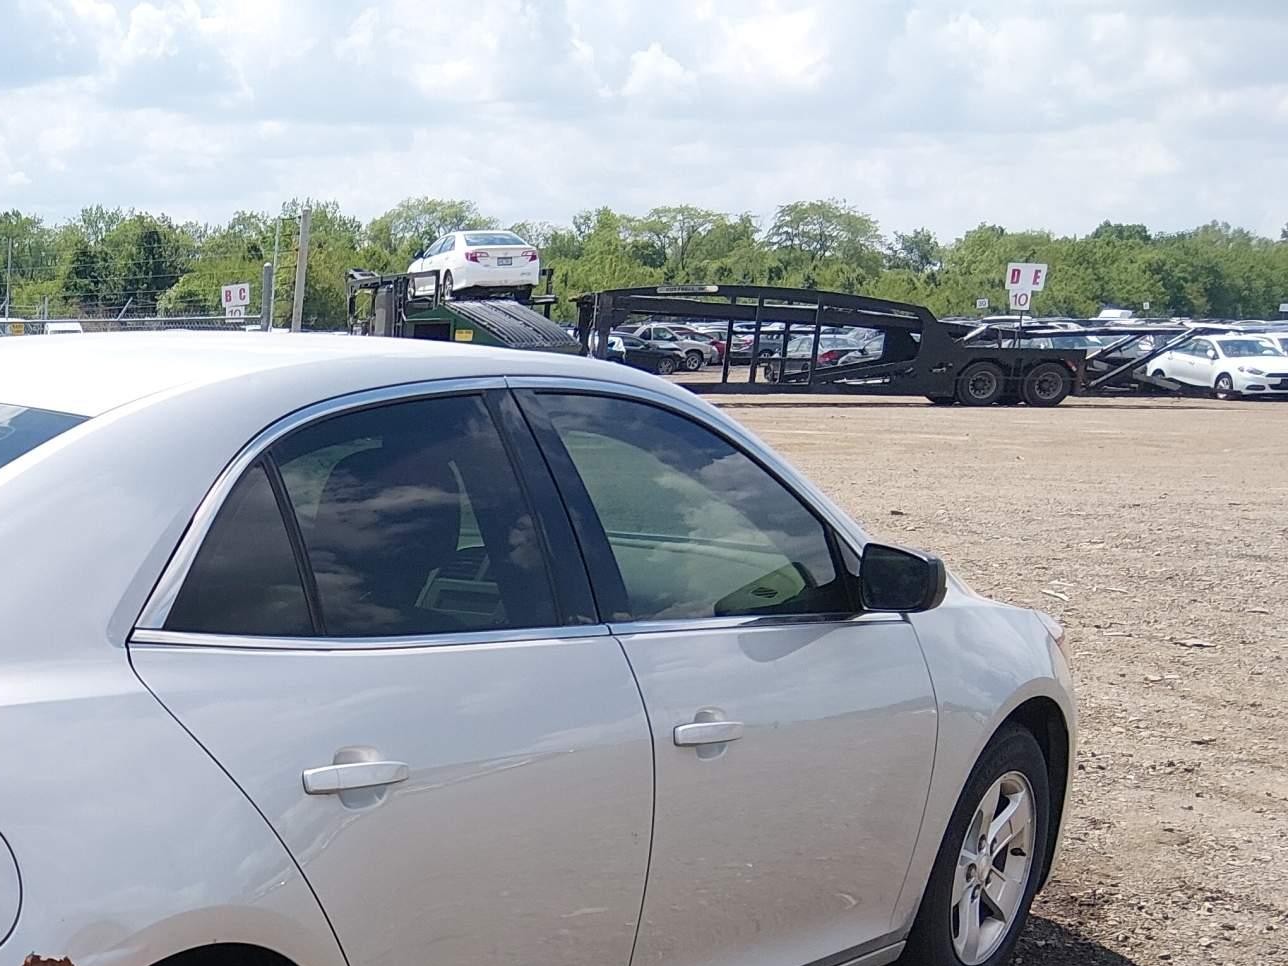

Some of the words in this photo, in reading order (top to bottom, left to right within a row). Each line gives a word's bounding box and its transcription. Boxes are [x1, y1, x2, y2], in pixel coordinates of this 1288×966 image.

[1010, 268, 1021, 284] D
[1032, 269, 1041, 285] E
[225, 290, 232, 302] B
[239, 287, 246, 300] C
[1012, 293, 1029, 306] 10
